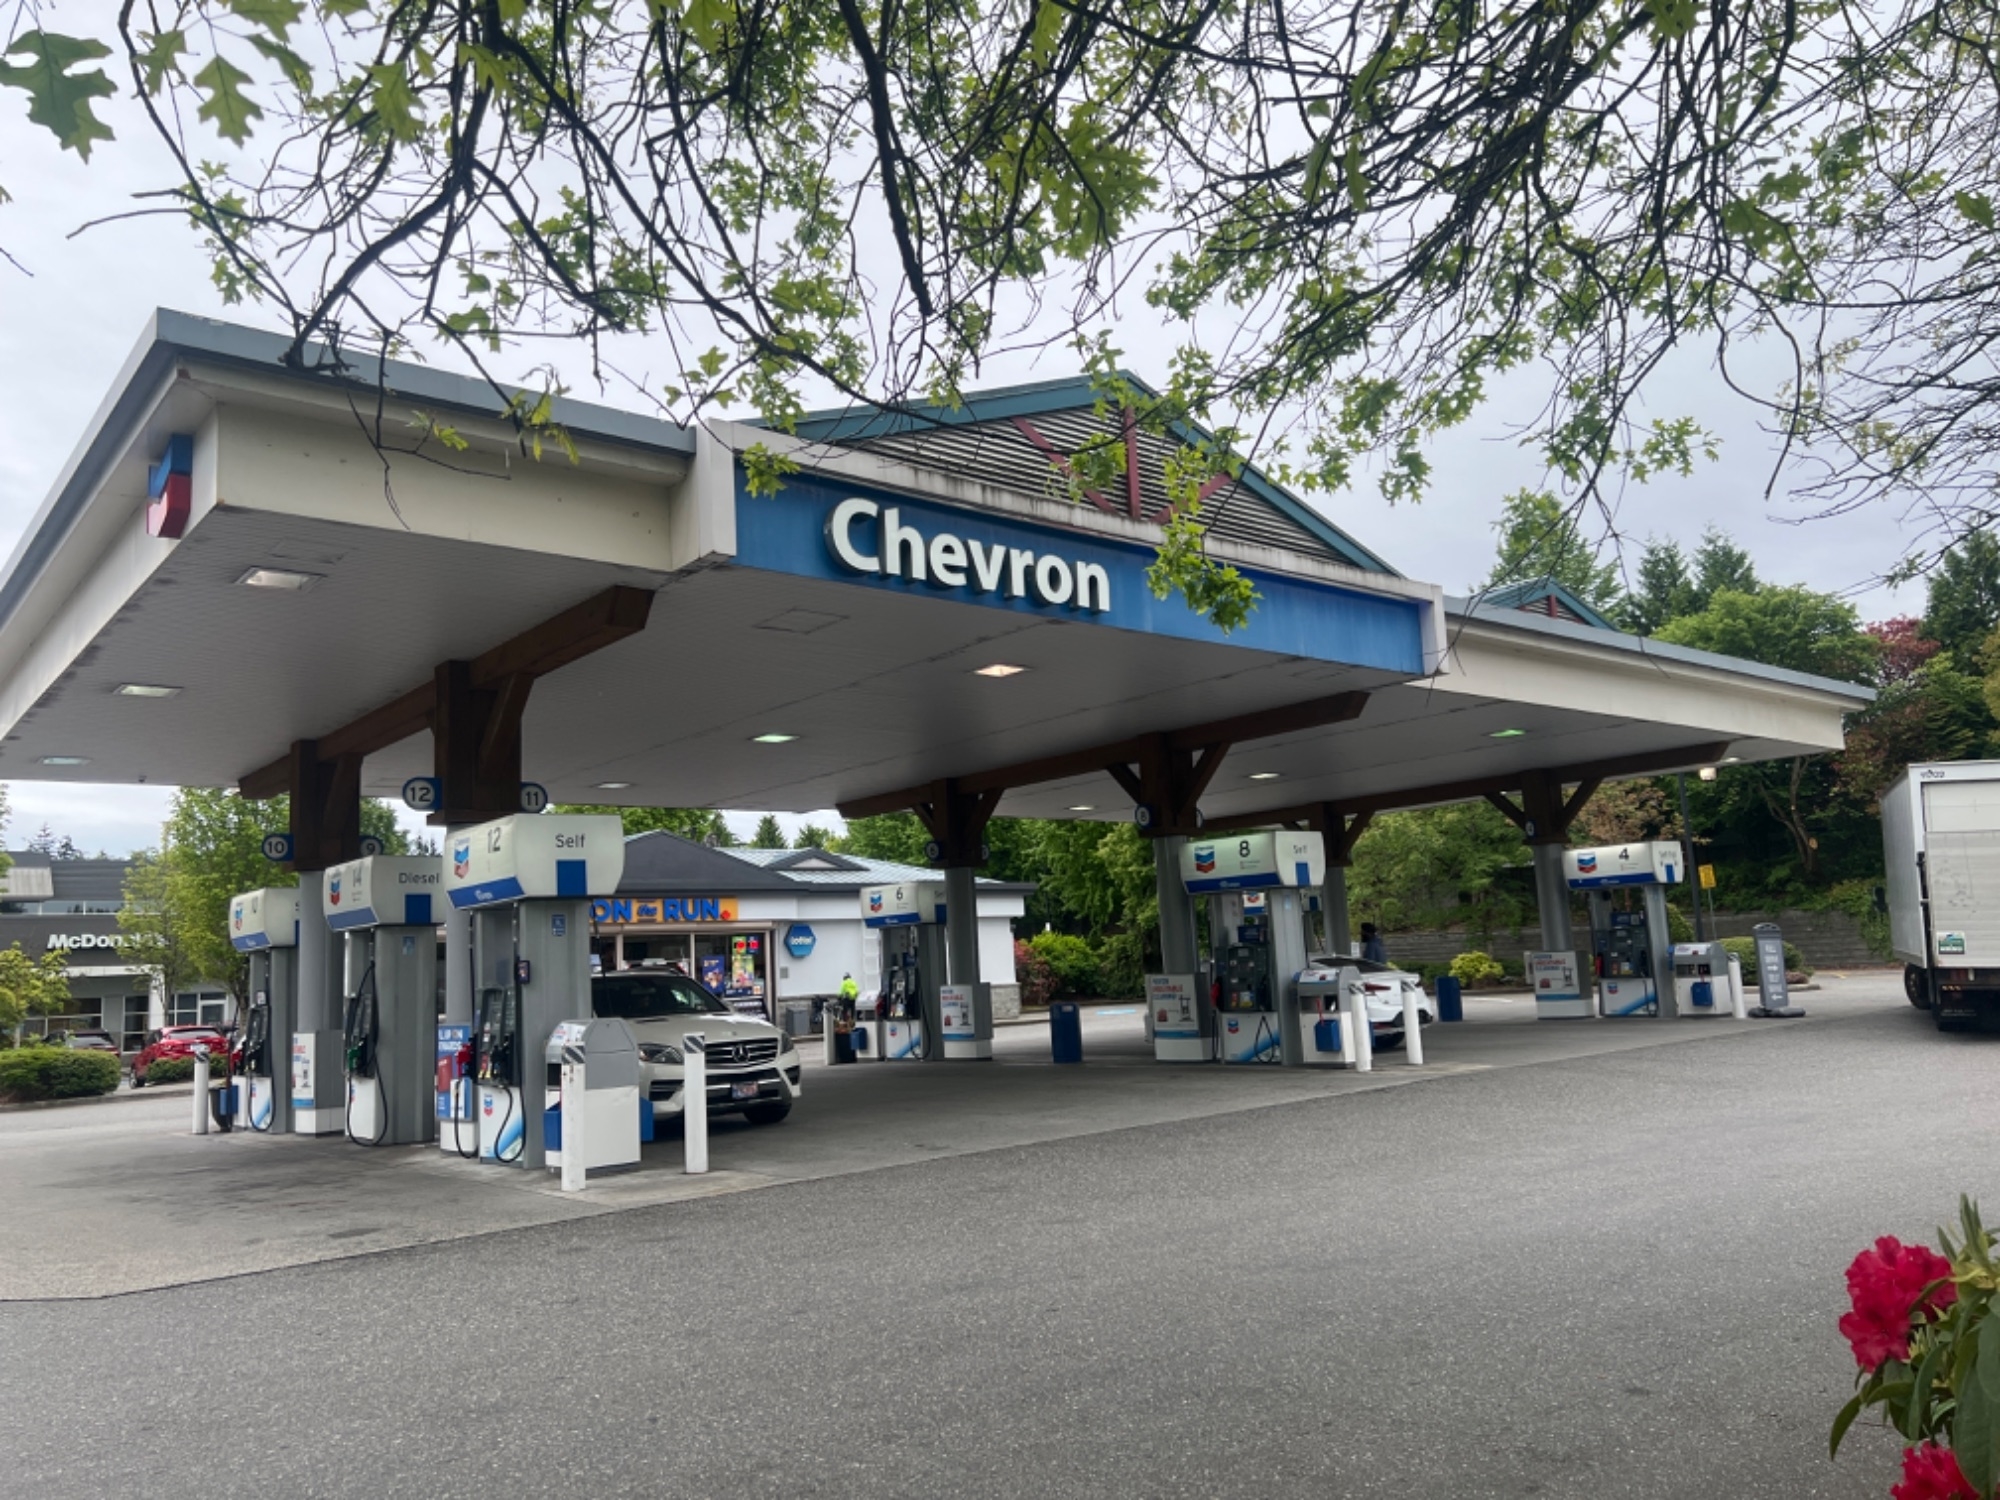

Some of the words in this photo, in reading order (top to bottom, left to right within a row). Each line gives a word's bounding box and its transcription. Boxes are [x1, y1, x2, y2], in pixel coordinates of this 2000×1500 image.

[825, 497, 1111, 612] Chevron
[409, 787, 432, 802] 12
[525, 791, 540, 806] 11
[267, 840, 285, 854] 10
[487, 826, 501, 853] 12
[555, 833, 586, 848] Self
[365, 842, 376, 856] 9
[1239, 840, 1250, 857] 8
[1618, 848, 1629, 861] 4
[398, 872, 440, 885] Diesel
[896, 886, 903, 901] 6
[590, 899, 632, 922] ON
[663, 899, 720, 921] RUN
